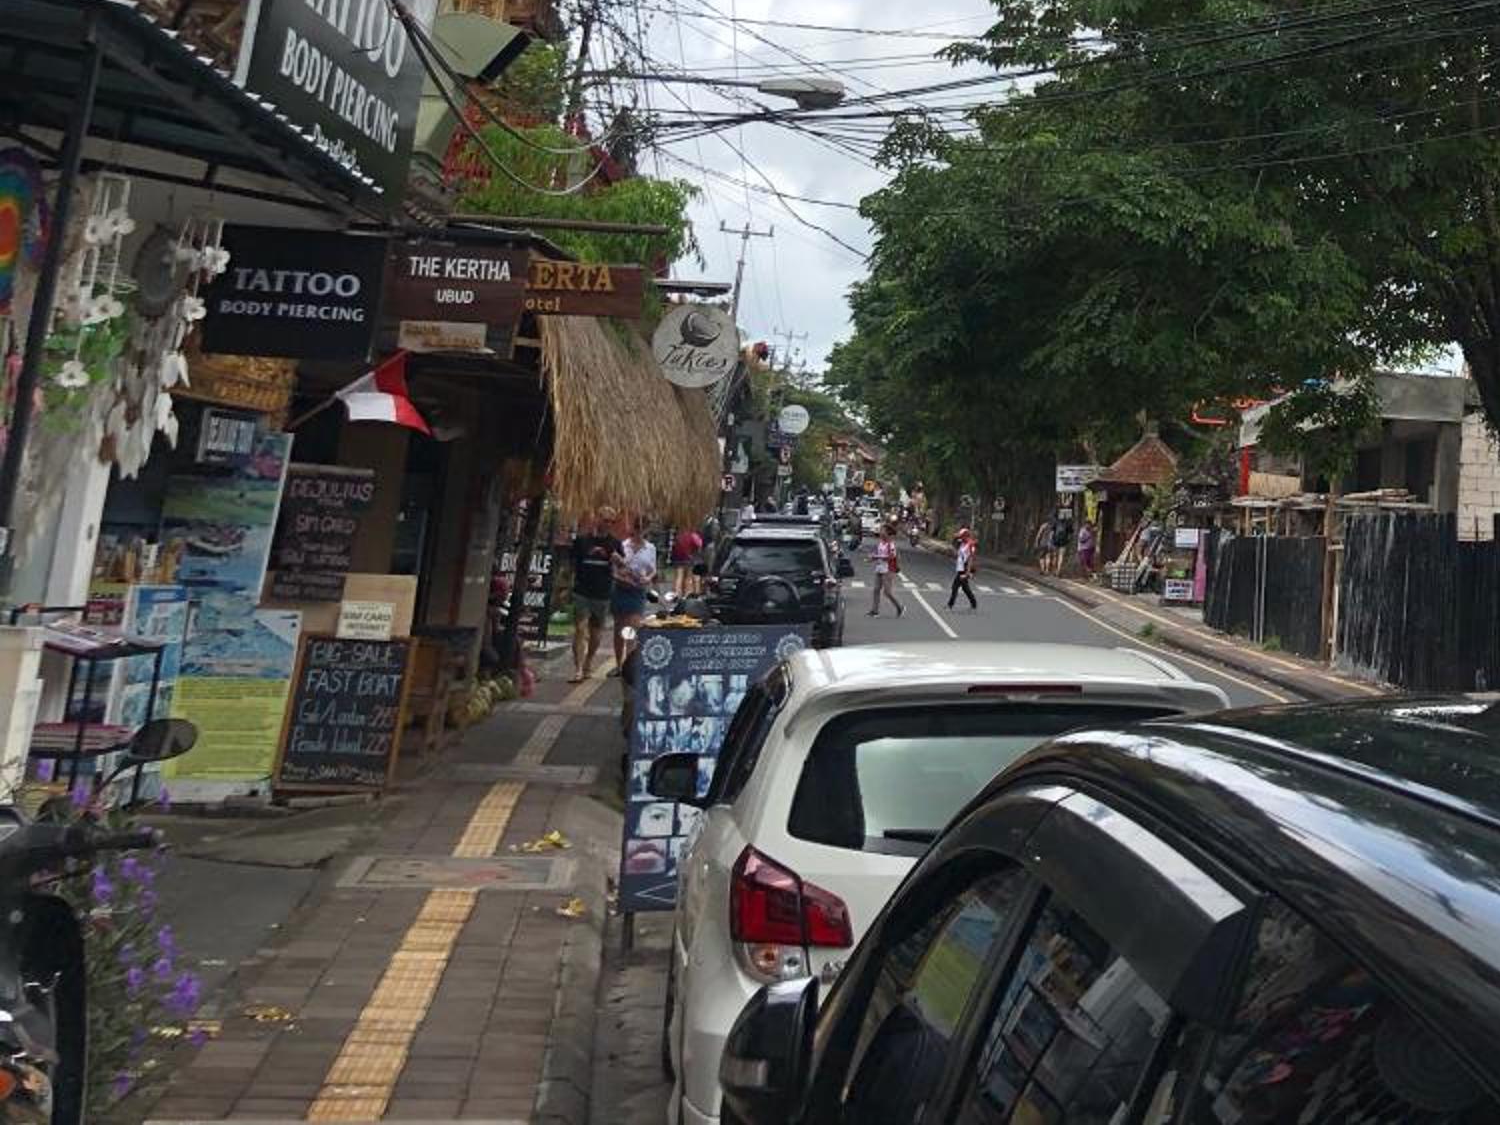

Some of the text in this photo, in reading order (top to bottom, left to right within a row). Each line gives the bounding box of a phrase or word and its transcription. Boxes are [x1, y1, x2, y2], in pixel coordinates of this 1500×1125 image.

[281, 27, 399, 153] BODY PIERCING
[409, 256, 511, 282] THE KERTHA
[524, 262, 615, 291] ERTA
[234, 267, 361, 297] TATTOO
[436, 289, 474, 304] UBUD
[525, 296, 561, 312] otel
[219, 300, 365, 322] BODY PIERCING
[305, 669, 354, 694] FAST
